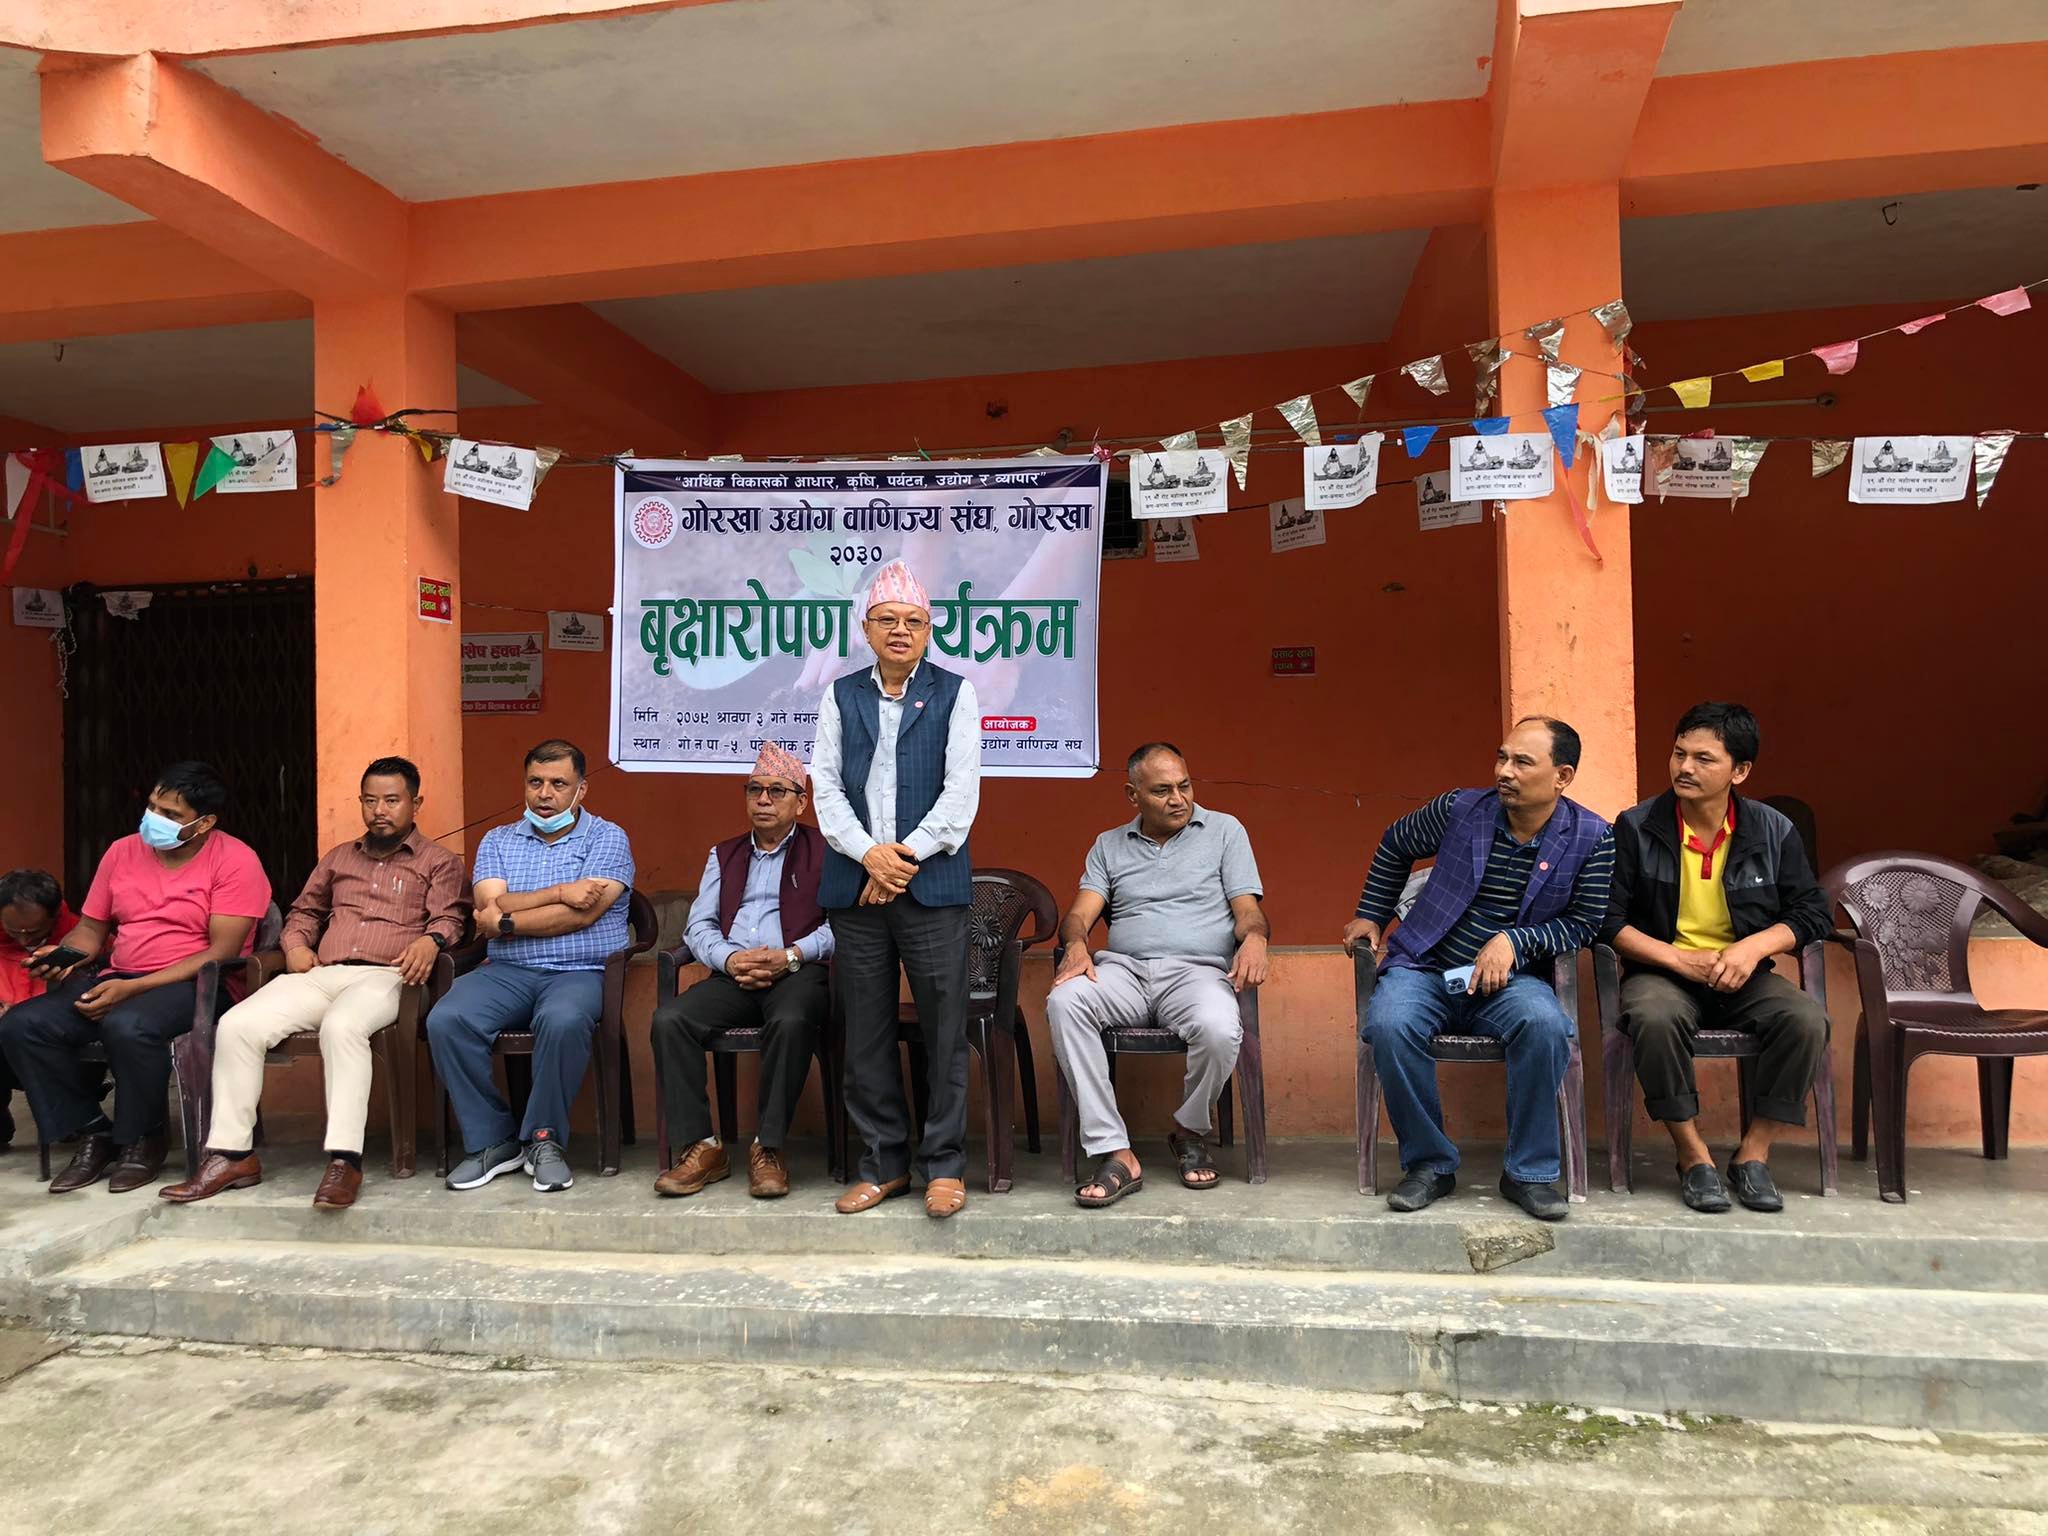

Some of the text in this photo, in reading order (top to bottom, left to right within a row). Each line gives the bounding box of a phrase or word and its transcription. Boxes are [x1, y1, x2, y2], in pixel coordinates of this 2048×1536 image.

[732, 475, 789, 488] विकासको
[794, 476, 839, 489] आधार,
[887, 472, 928, 488] पर्यटन,
[936, 472, 974, 486] उद्योग
[978, 473, 990, 486] र
[682, 499, 762, 533] गोरखा
[769, 499, 836, 533] उद्योग
[843, 497, 943, 533] वाणिज्य
[950, 500, 999, 533] संघ,
[1008, 496, 1094, 532] गोरखा
[830, 546, 882, 566] २०३०
[633, 707, 659, 723] मिति
[676, 711, 710, 725] २०७९
[717, 712, 751, 725] श्रावण
[757, 712, 763, 726] ३
[771, 709, 788, 724] गते
[983, 718, 1035, 729] आयोजक:
[633, 738, 661, 751] स्थान
[981, 736, 1010, 749] उद्योग
[1016, 735, 1059, 750] वाणिज्य
